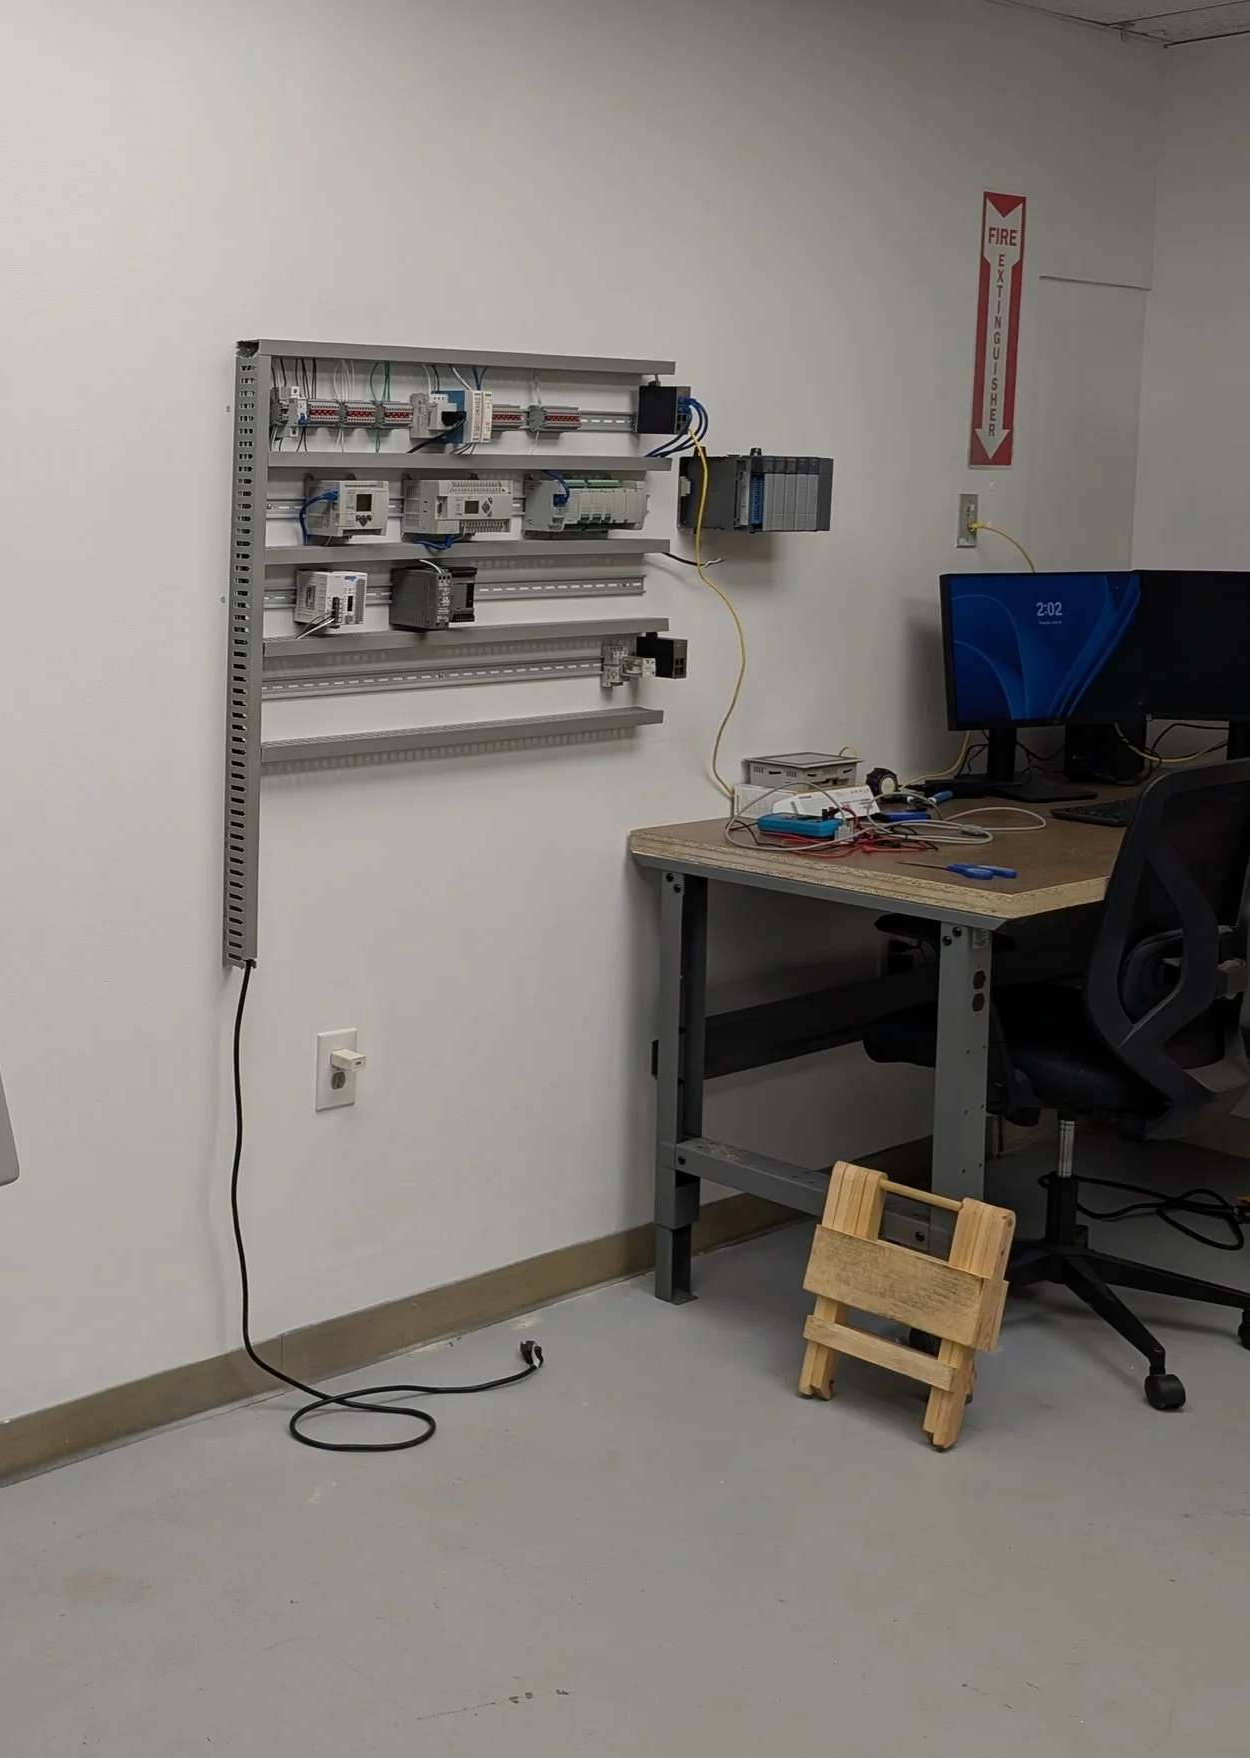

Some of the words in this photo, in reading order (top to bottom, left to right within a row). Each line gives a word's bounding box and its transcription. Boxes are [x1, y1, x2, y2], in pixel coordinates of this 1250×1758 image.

[988, 227, 1018, 246] FIRE
[988, 254, 1006, 437] EXTINGUISHER
[1036, 602, 1063, 616] 2:02
